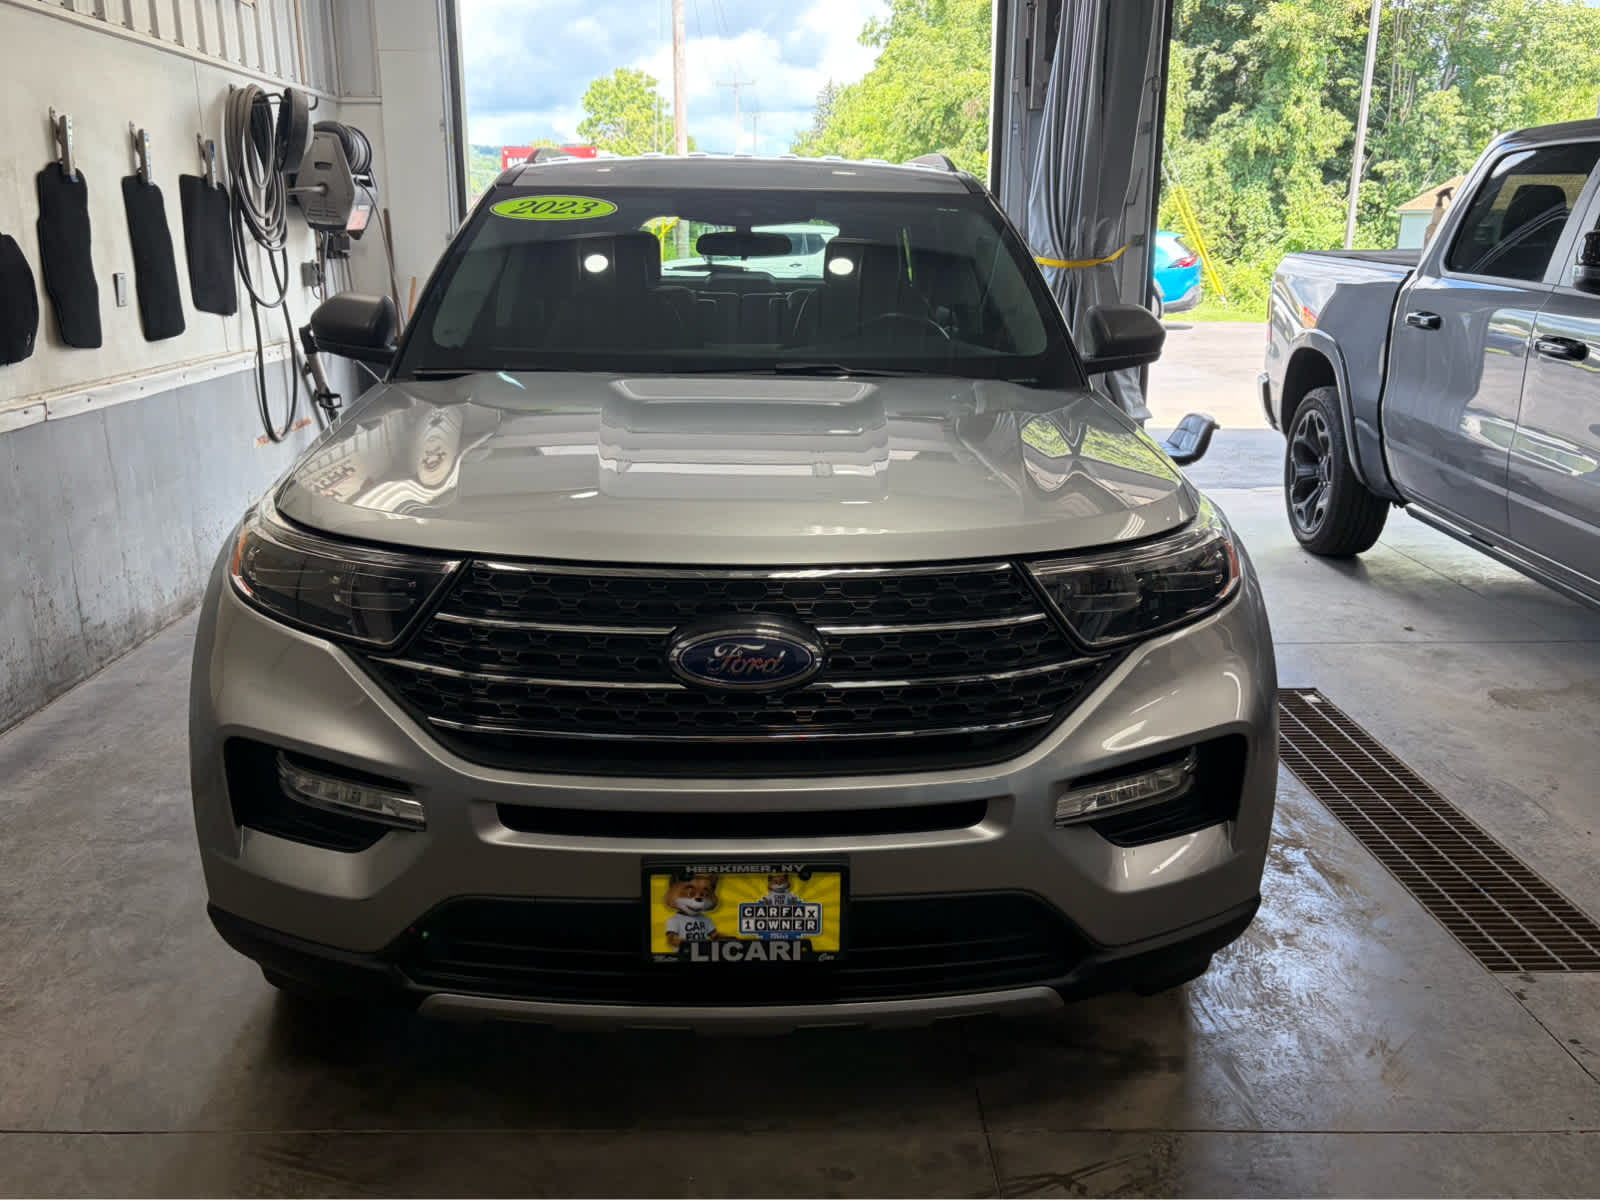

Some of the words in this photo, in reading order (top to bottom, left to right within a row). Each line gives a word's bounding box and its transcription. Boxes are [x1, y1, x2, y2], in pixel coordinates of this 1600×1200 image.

[508, 200, 600, 215] 2023
[706, 642, 786, 675] Ford
[781, 864, 806, 872] NY
[743, 906, 817, 919] CARFAX
[684, 922, 705, 932] CAR
[756, 920, 817, 930] OWNER
[690, 941, 801, 962] LICARI
